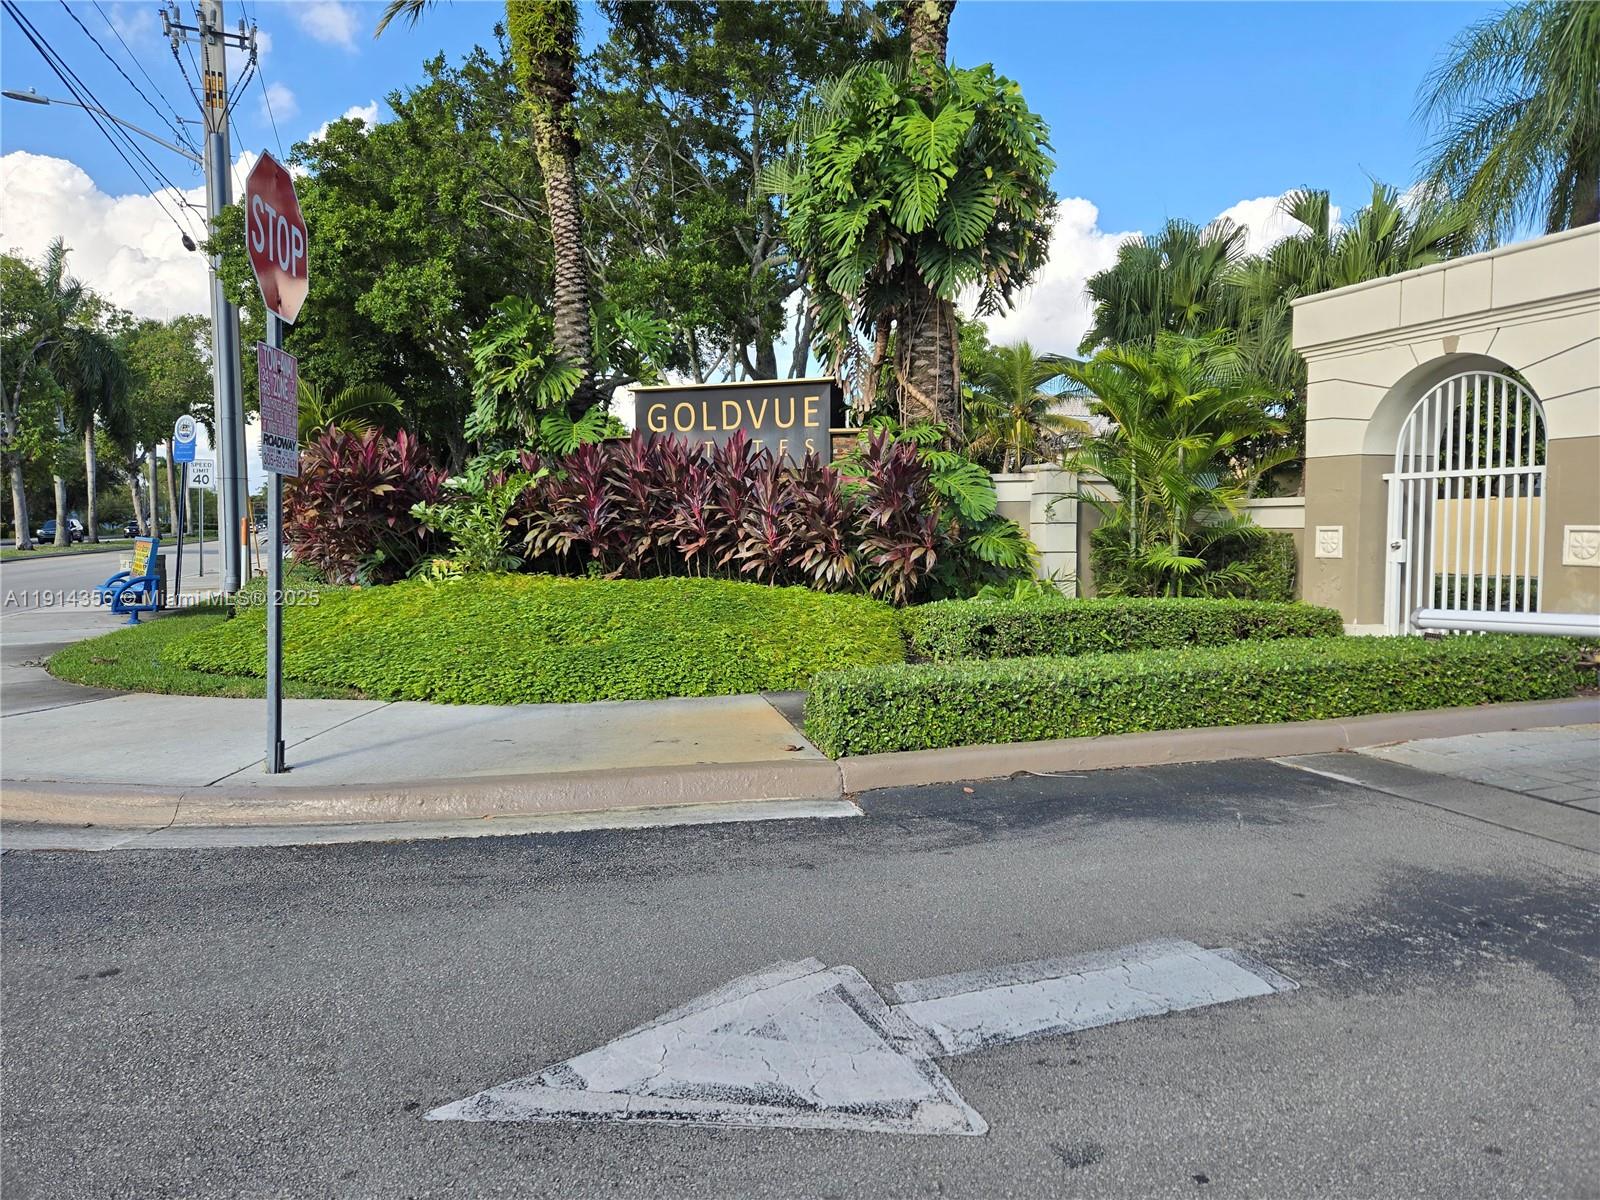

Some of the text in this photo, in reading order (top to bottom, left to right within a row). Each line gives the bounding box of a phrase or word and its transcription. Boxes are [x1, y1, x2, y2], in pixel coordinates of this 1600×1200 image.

[252, 194, 304, 277] STOP
[647, 396, 820, 433] GOLDVUE
[263, 433, 297, 451] ROADWAY
[192, 474, 210, 485] 40
